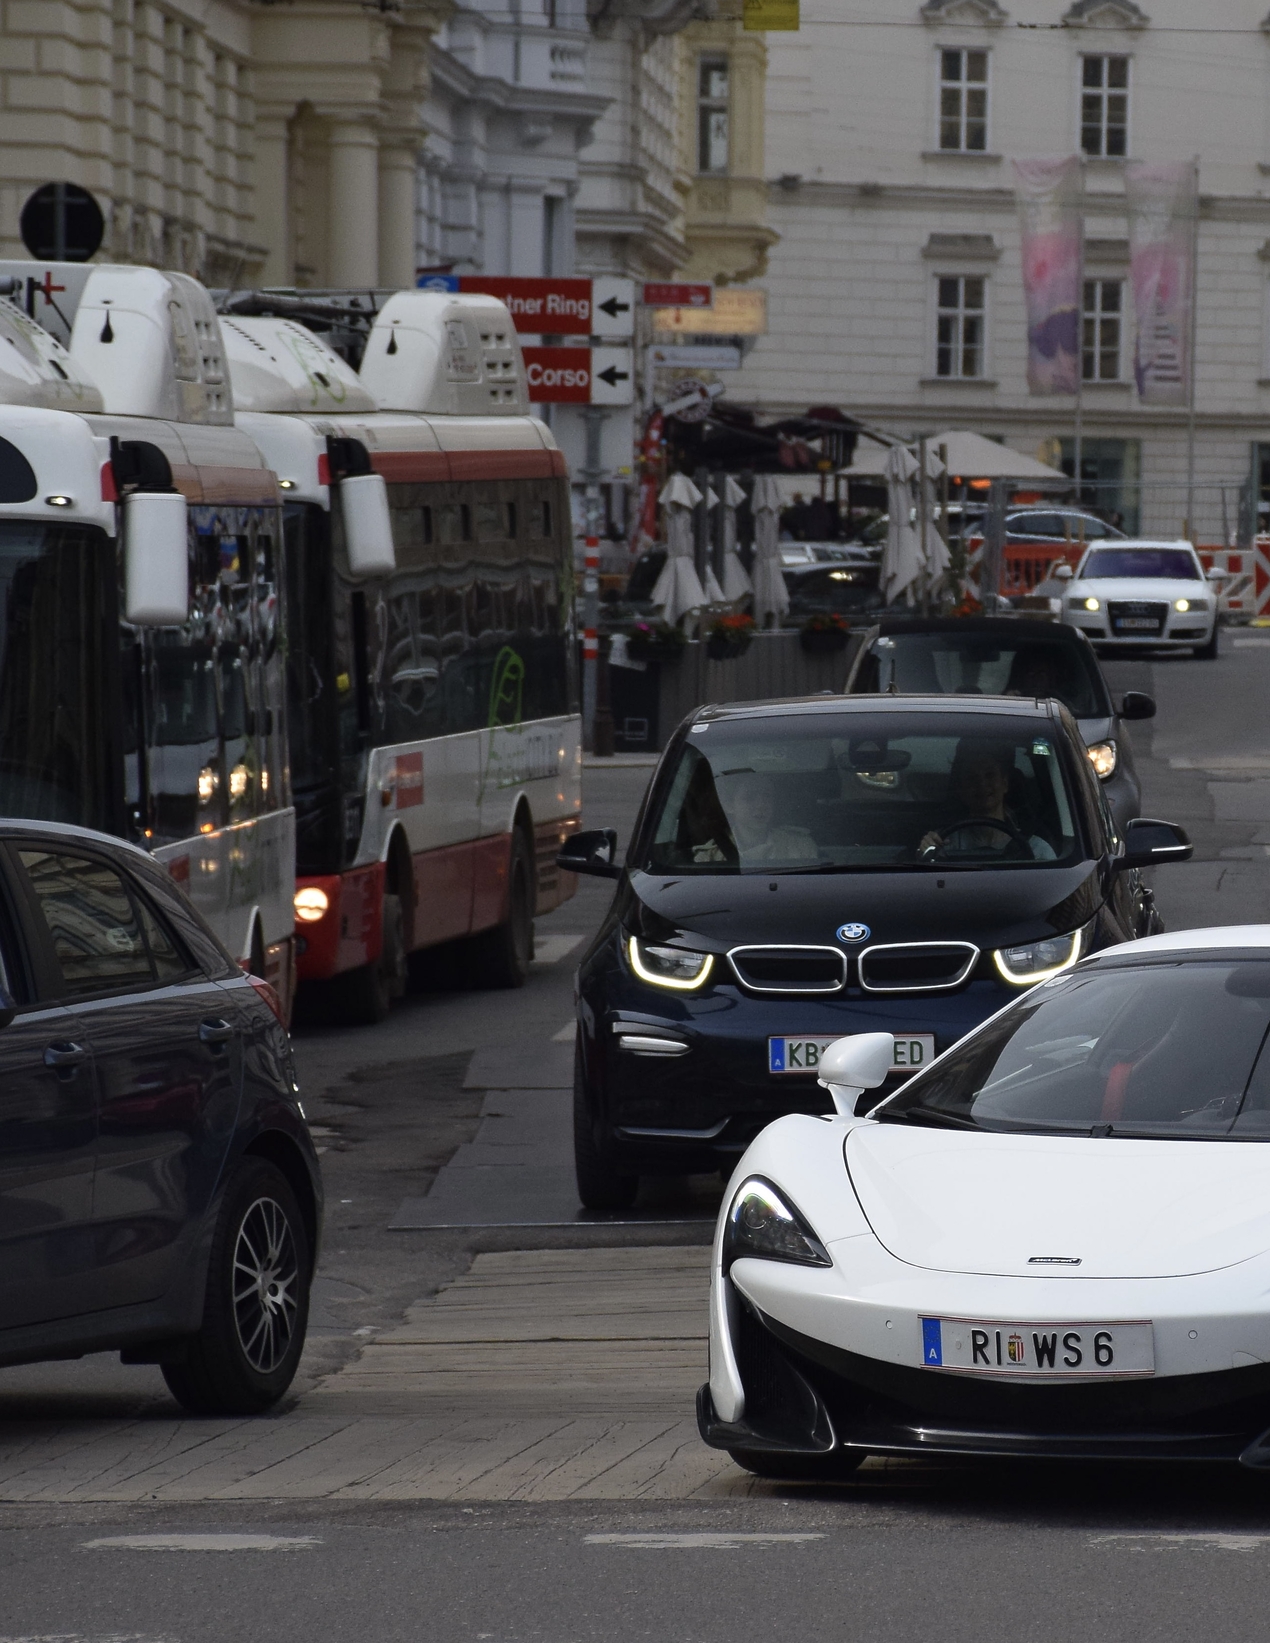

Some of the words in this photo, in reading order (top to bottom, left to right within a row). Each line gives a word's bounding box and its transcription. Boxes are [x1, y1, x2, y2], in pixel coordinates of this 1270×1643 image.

[546, 294, 590, 321] Ring
[526, 363, 588, 387] Corso
[788, 1042, 819, 1068] KB
[929, 1348, 937, 1360] A
[971, 1329, 1002, 1366] RI
[1032, 1331, 1083, 1369] WS
[1094, 1330, 1114, 1367] 6
